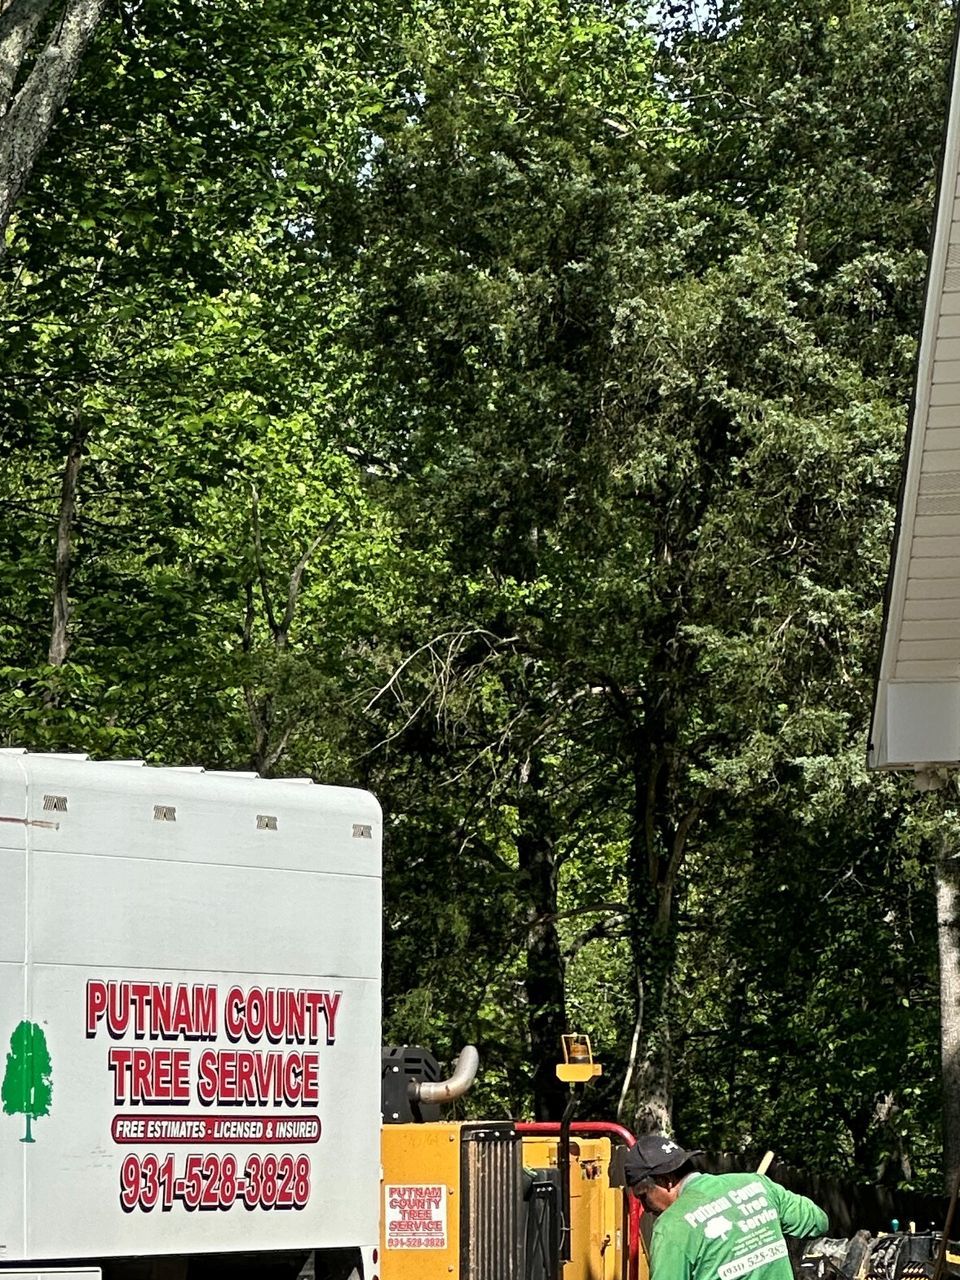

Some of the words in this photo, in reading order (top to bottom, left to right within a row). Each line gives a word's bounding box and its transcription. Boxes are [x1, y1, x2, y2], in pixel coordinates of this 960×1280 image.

[86, 979, 218, 1041] PUTNAM
[225, 986, 342, 1045] COUNTY
[108, 1047, 190, 1106] TREE
[197, 1049, 320, 1107] SERVICE
[115, 1121, 145, 1138] FREE
[147, 1121, 206, 1138] ESTIMATES
[214, 1121, 263, 1138] LICENSED
[266, 1121, 273, 1138] &
[276, 1121, 318, 1138] INSURED
[120, 1153, 311, 1213] 931-528-3828
[389, 1187, 442, 1198] PUTNAM
[389, 1198, 441, 1209] COUNTY
[684, 1197, 732, 1228] Putnam
[737, 1197, 768, 1216] Tree
[399, 1210, 432, 1220] TREE
[389, 1220, 443, 1231] SERVICE
